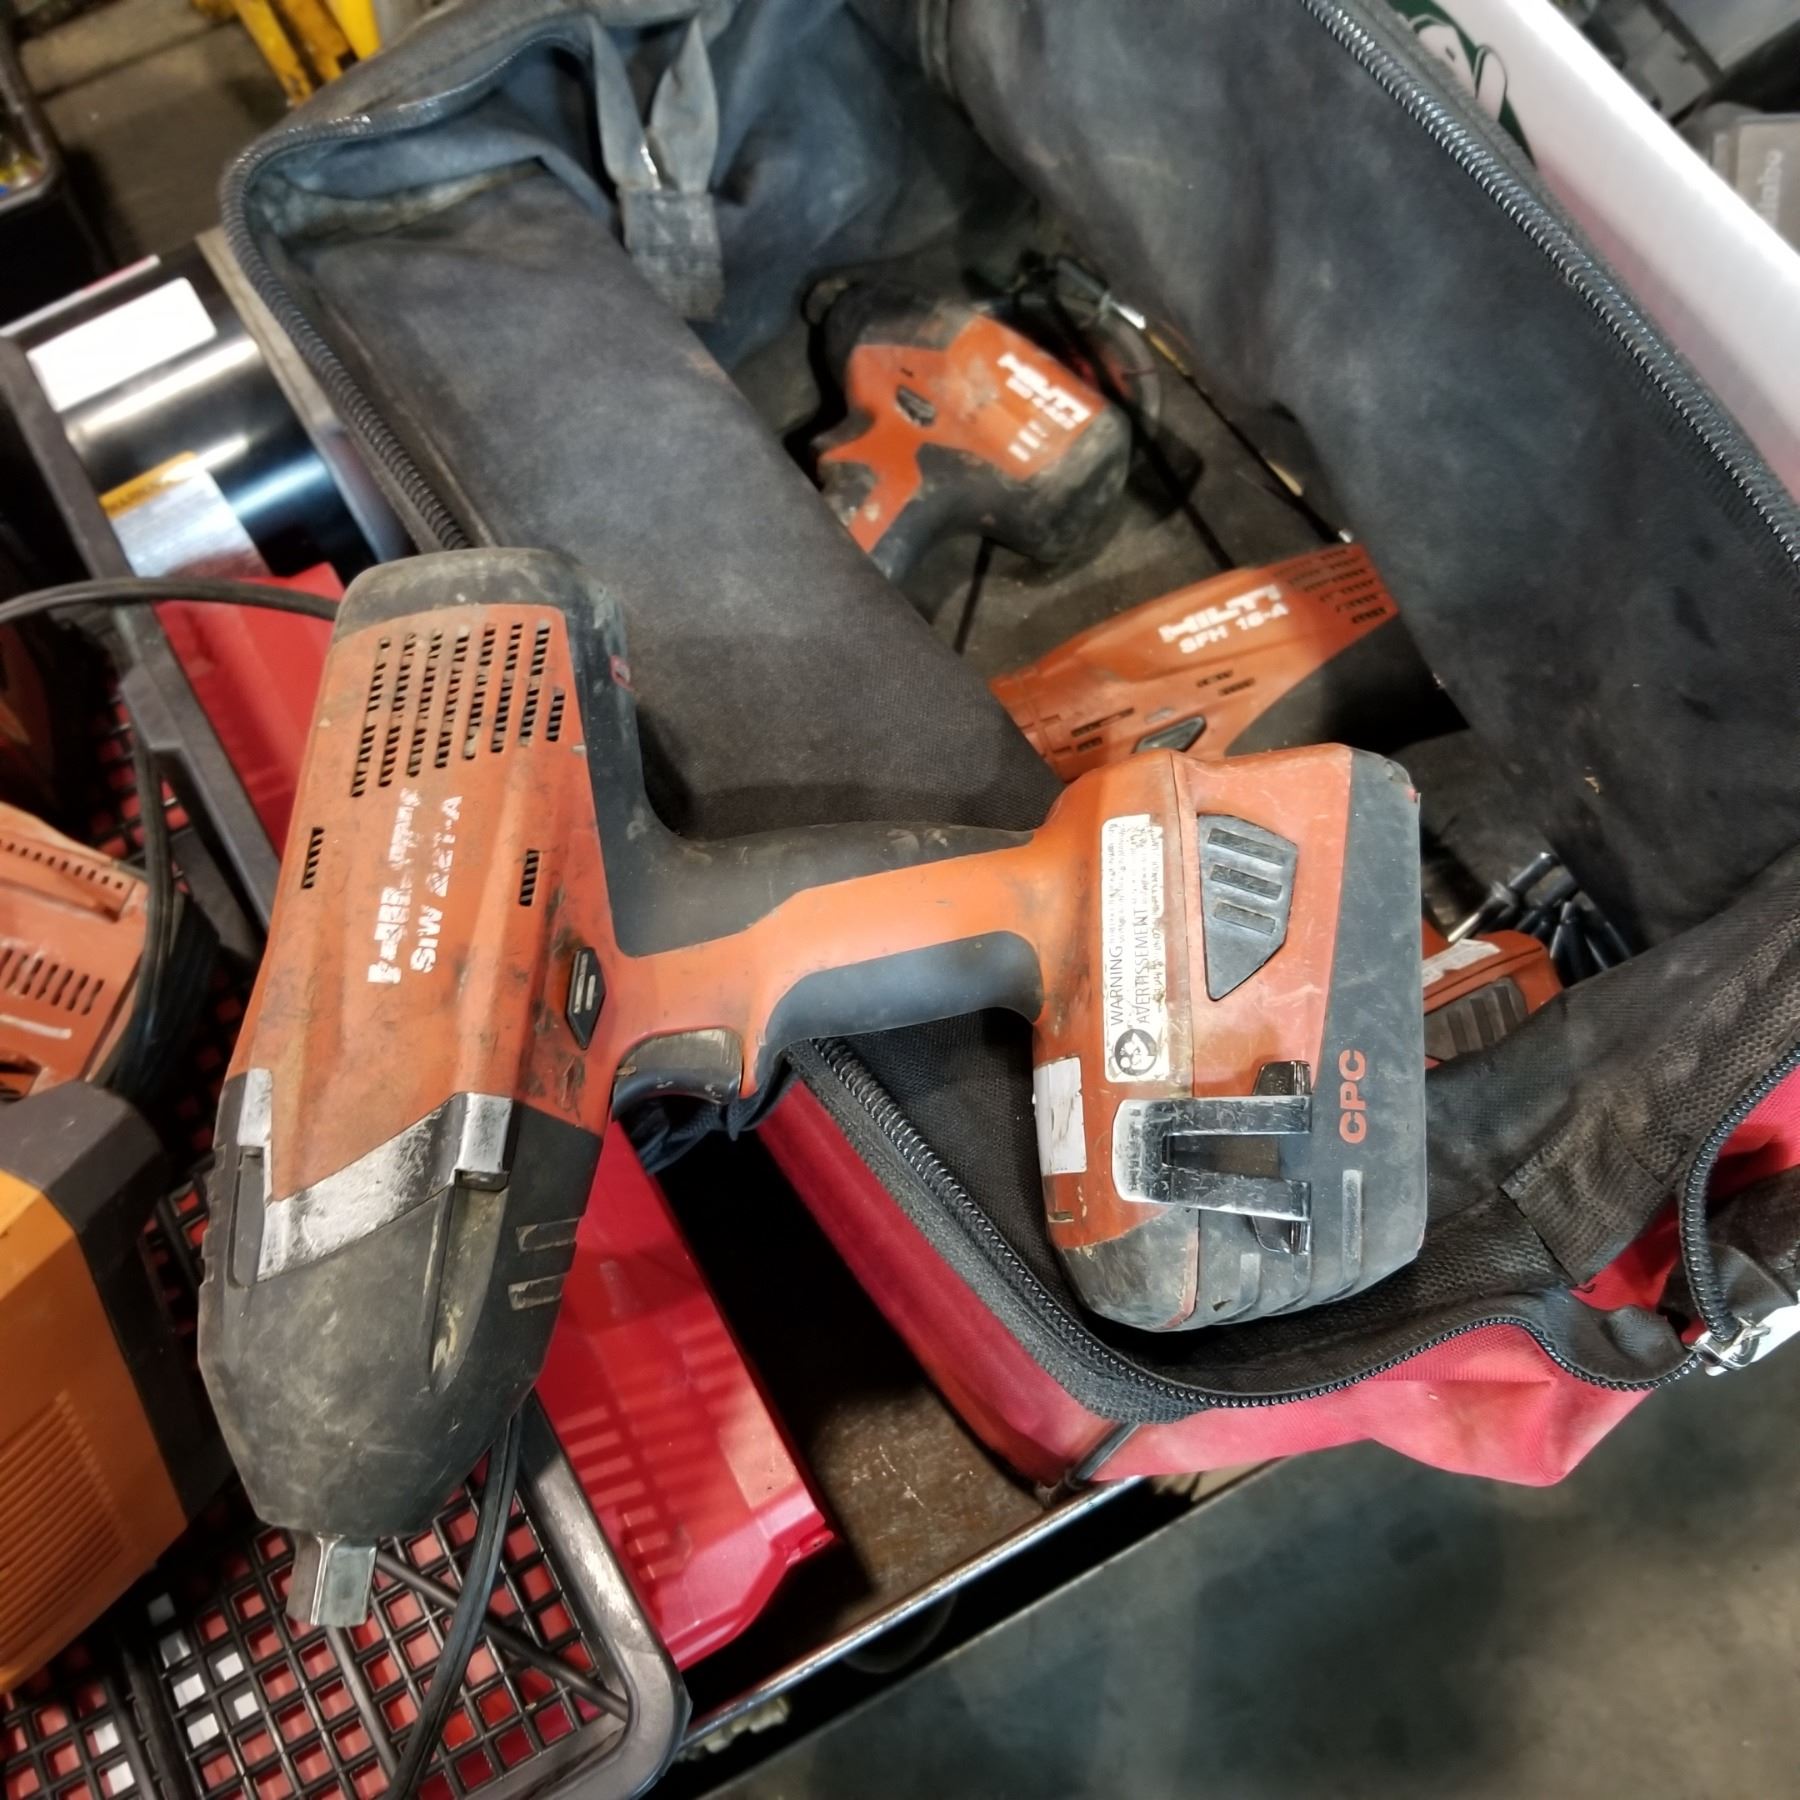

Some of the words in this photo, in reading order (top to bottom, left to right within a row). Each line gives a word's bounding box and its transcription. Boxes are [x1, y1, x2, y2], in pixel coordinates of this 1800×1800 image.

[1158, 584, 1281, 643] HILTI
[410, 904, 443, 973] SIW
[1133, 908, 1151, 1024] AVERTISSEMENT
[1109, 945, 1125, 1026] WARNING
[1338, 1049, 1367, 1144] CPC
